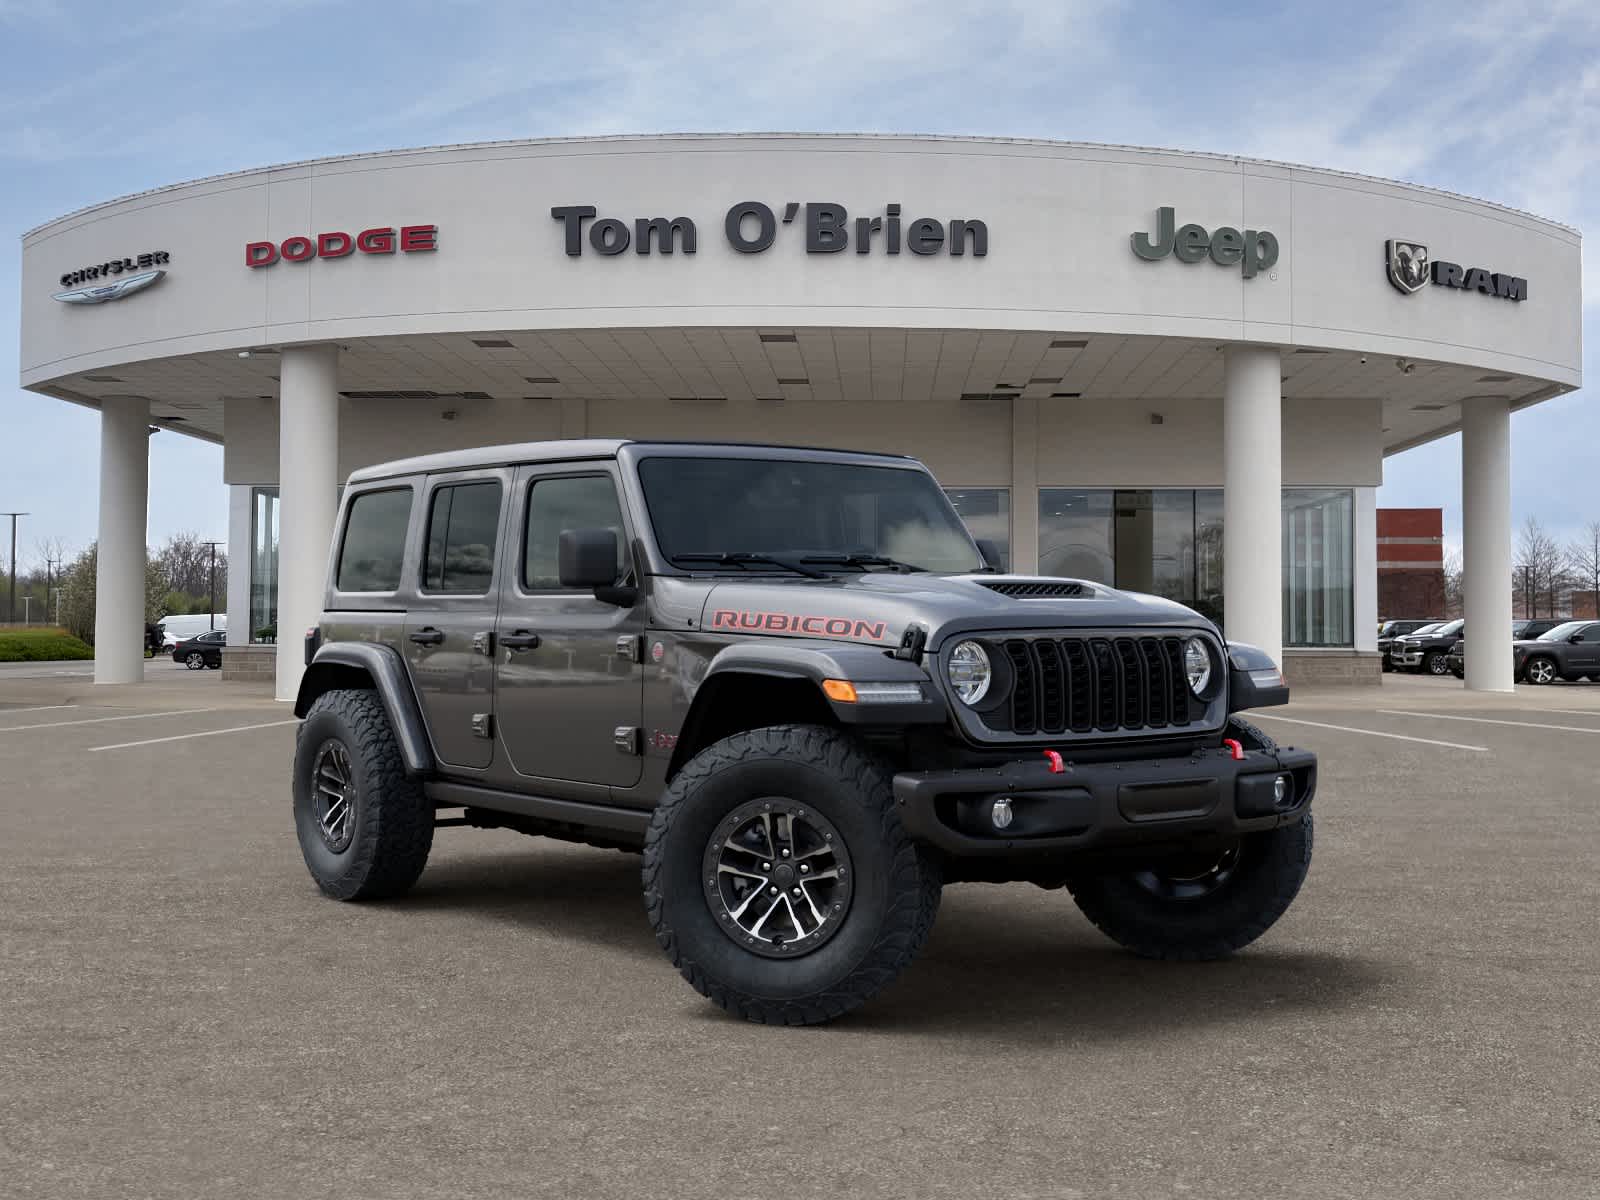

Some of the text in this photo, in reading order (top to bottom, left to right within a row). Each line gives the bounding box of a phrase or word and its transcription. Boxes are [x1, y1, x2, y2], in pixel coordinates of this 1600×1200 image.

[246, 225, 438, 269] DODGE
[551, 201, 988, 256] Tom O'Brien
[1130, 206, 1279, 279] Jeep
[60, 250, 170, 287] CHRYSLER
[1430, 261, 1527, 301] RAM
[713, 609, 888, 640] RUBICON
